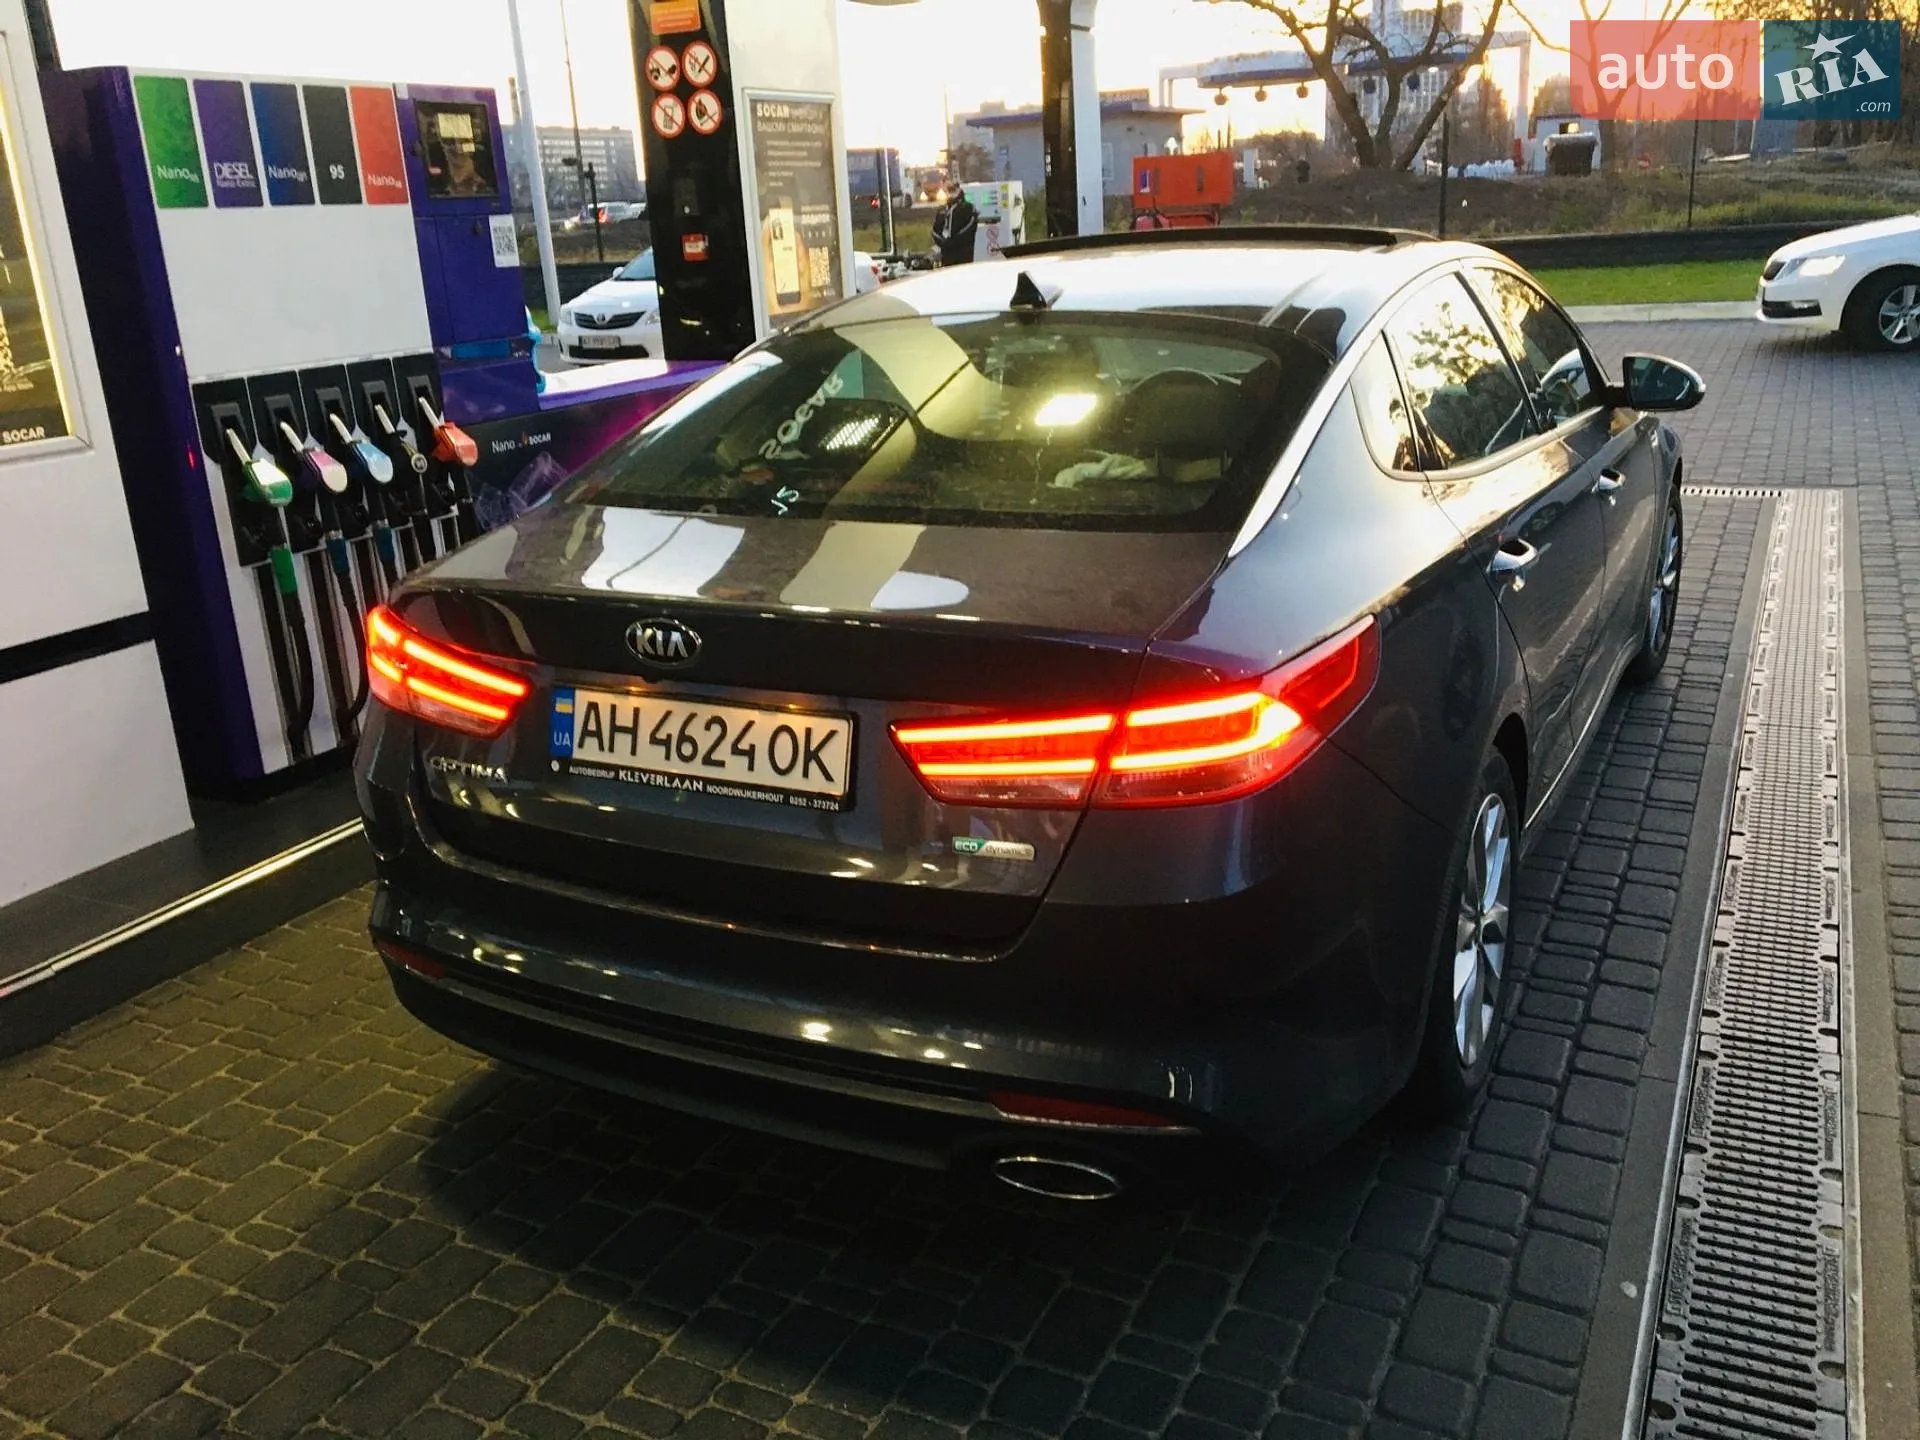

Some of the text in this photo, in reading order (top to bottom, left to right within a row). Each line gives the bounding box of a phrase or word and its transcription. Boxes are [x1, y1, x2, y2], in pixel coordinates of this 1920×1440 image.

[756, 103, 789, 117] SOCAR
[214, 162, 256, 180] DIESEL
[329, 164, 345, 180] 95
[2, 426, 45, 444] SOCAR
[492, 440, 516, 454] Nano
[635, 625, 689, 657] KIA
[553, 731, 571, 747] UA
[577, 700, 838, 782] AH 4624 OK
[429, 755, 508, 784] OPTIMA
[619, 769, 703, 792] KLEVERLAAN
[706, 784, 784, 804] NOORDWIJKERHOUT
